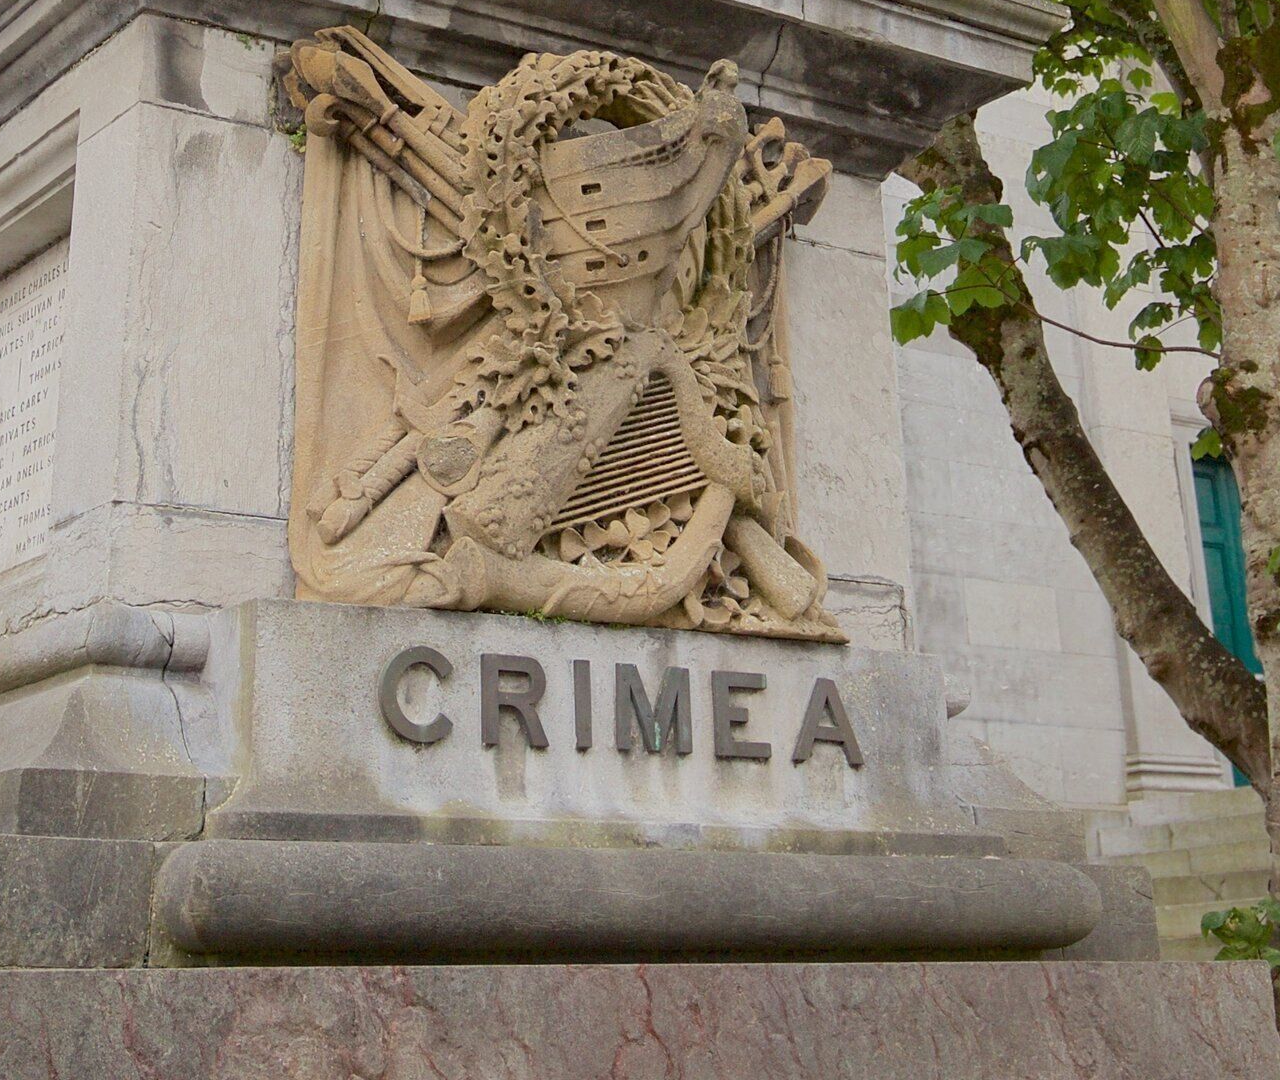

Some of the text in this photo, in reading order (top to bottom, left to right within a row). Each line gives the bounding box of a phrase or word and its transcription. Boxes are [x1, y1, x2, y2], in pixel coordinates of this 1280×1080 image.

[28, 265, 60, 295] CHARLES
[18, 296, 52, 326] SULLIVAN
[30, 358, 62, 384] THOMAS
[20, 387, 49, 412] CAREY
[18, 504, 51, 528] THOMAS
[15, 532, 46, 555] MARTIN
[377, 645, 864, 768] CRIMEA
